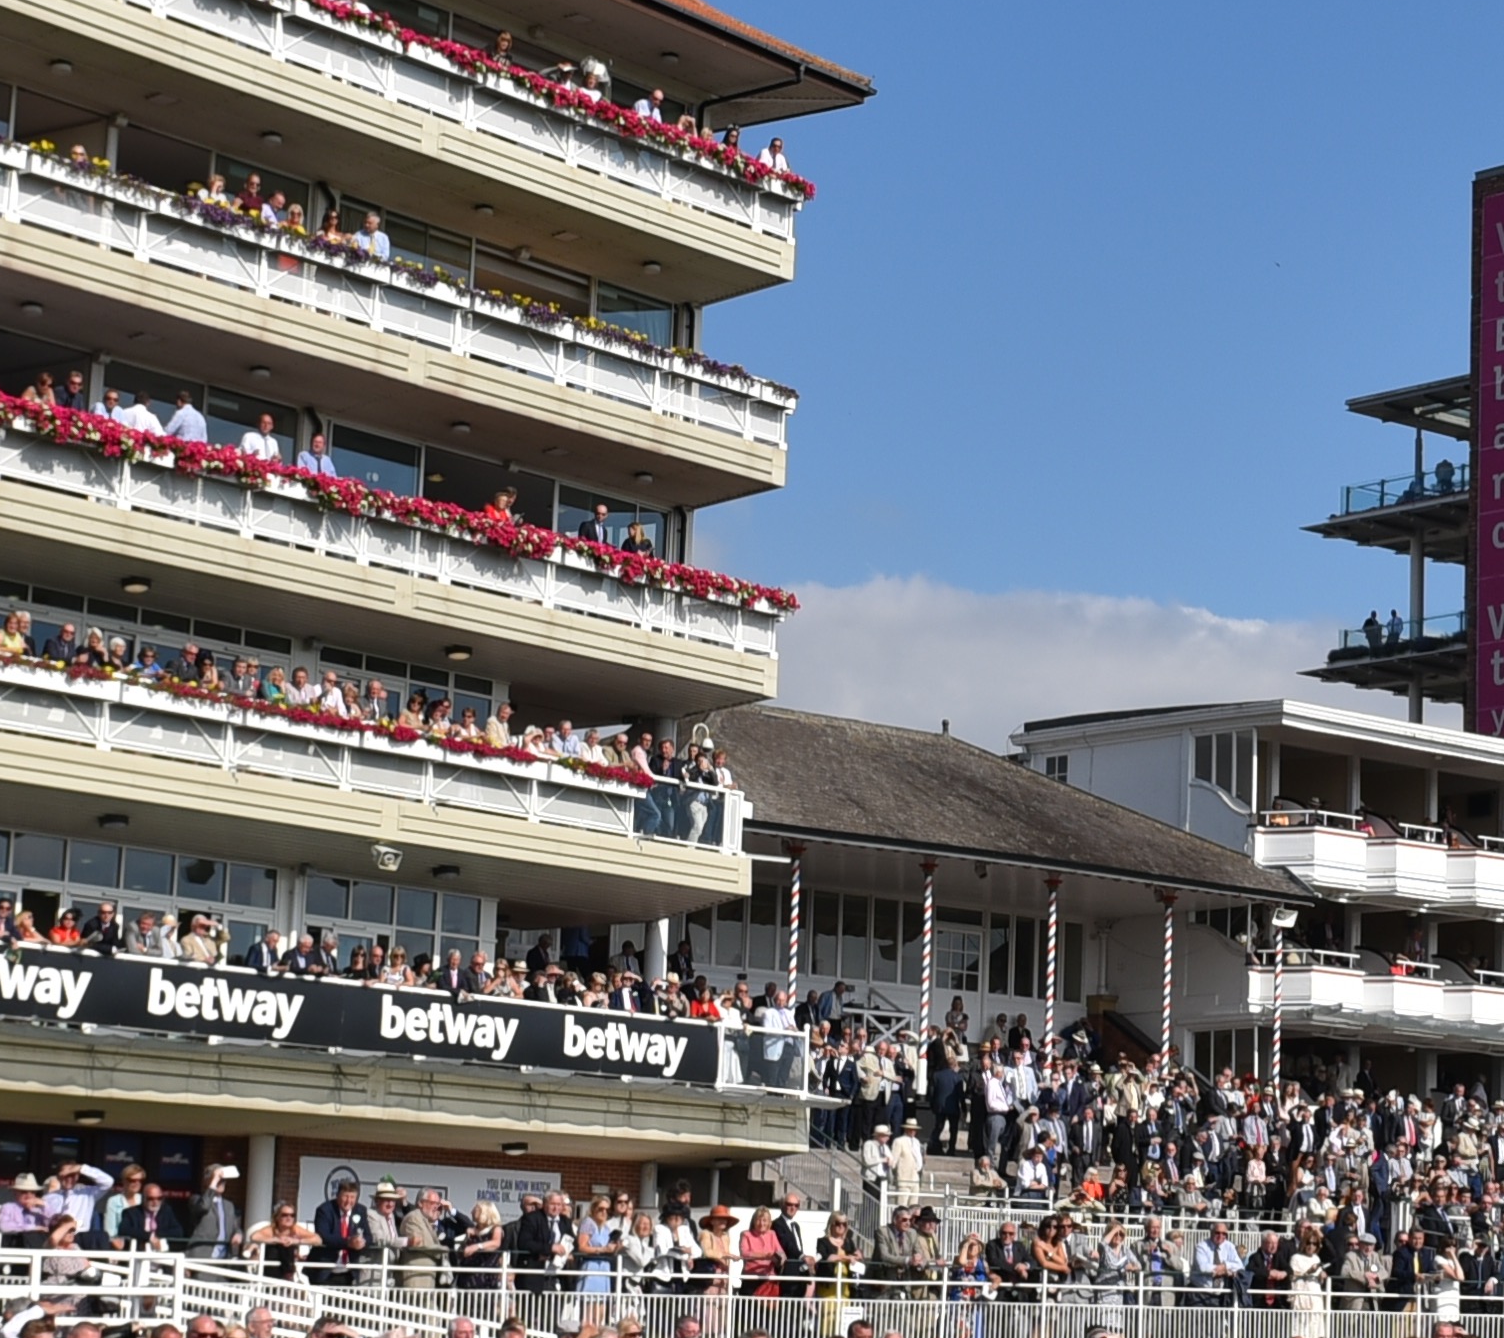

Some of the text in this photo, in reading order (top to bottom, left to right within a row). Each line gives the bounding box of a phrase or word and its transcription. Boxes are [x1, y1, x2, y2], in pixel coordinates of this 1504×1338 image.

[147, 967, 305, 1040] betway
[380, 993, 520, 1061] betway
[563, 1020, 689, 1079] betway
[476, 1189, 500, 1202] RACING
[486, 1178, 499, 1190] YOU
[500, 1179, 513, 1190] CAN
[514, 1179, 529, 1191] NOW
